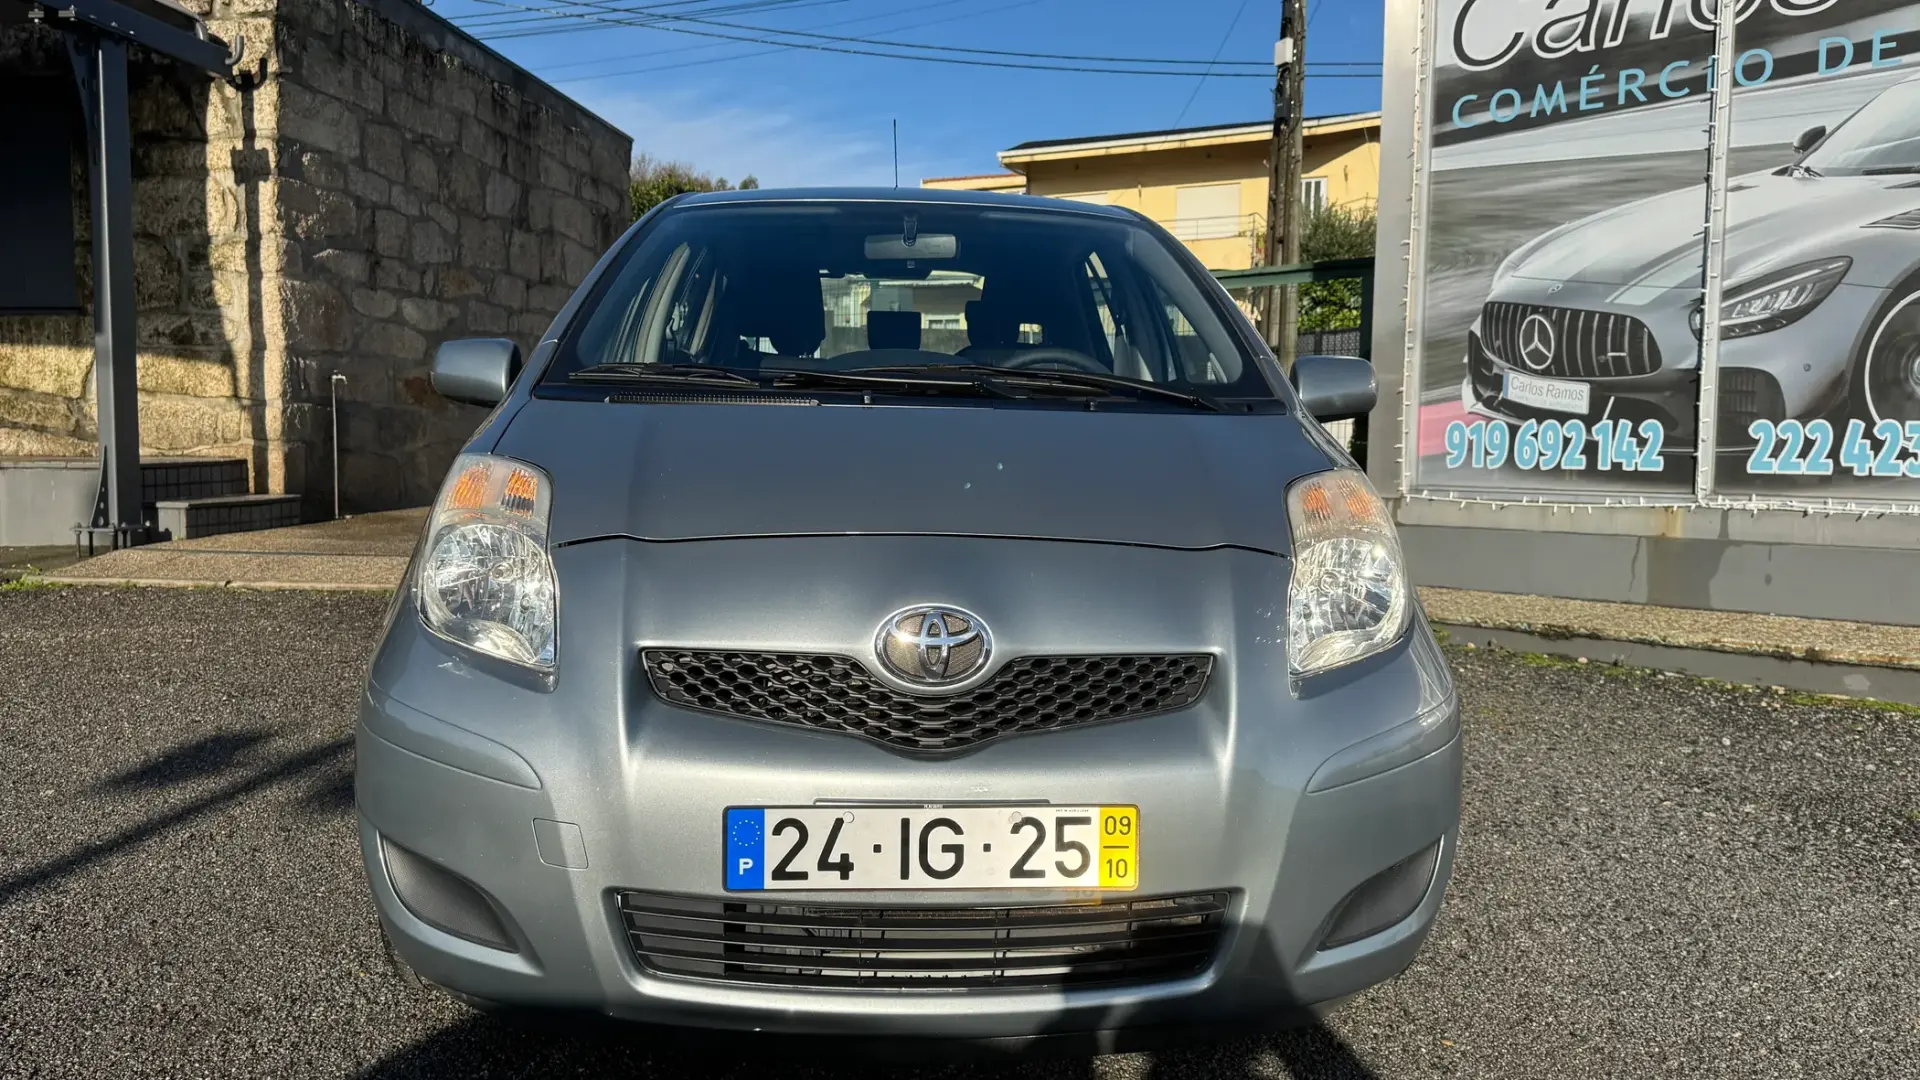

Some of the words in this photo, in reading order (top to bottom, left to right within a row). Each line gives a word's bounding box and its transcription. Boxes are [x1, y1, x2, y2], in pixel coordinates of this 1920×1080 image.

[1452, 48, 1774, 129] COMÉRCIO
[1818, 28, 1904, 76] DE
[1510, 376, 1544, 397] Carlos
[1545, 383, 1585, 401] Ramos
[1446, 419, 1509, 470] 919
[1514, 419, 1587, 471] 692
[1597, 419, 1665, 472] 142
[1747, 419, 1834, 476] 222
[1104, 815, 1132, 836] 09
[739, 857, 754, 876] P
[1105, 858, 1128, 879] 10
